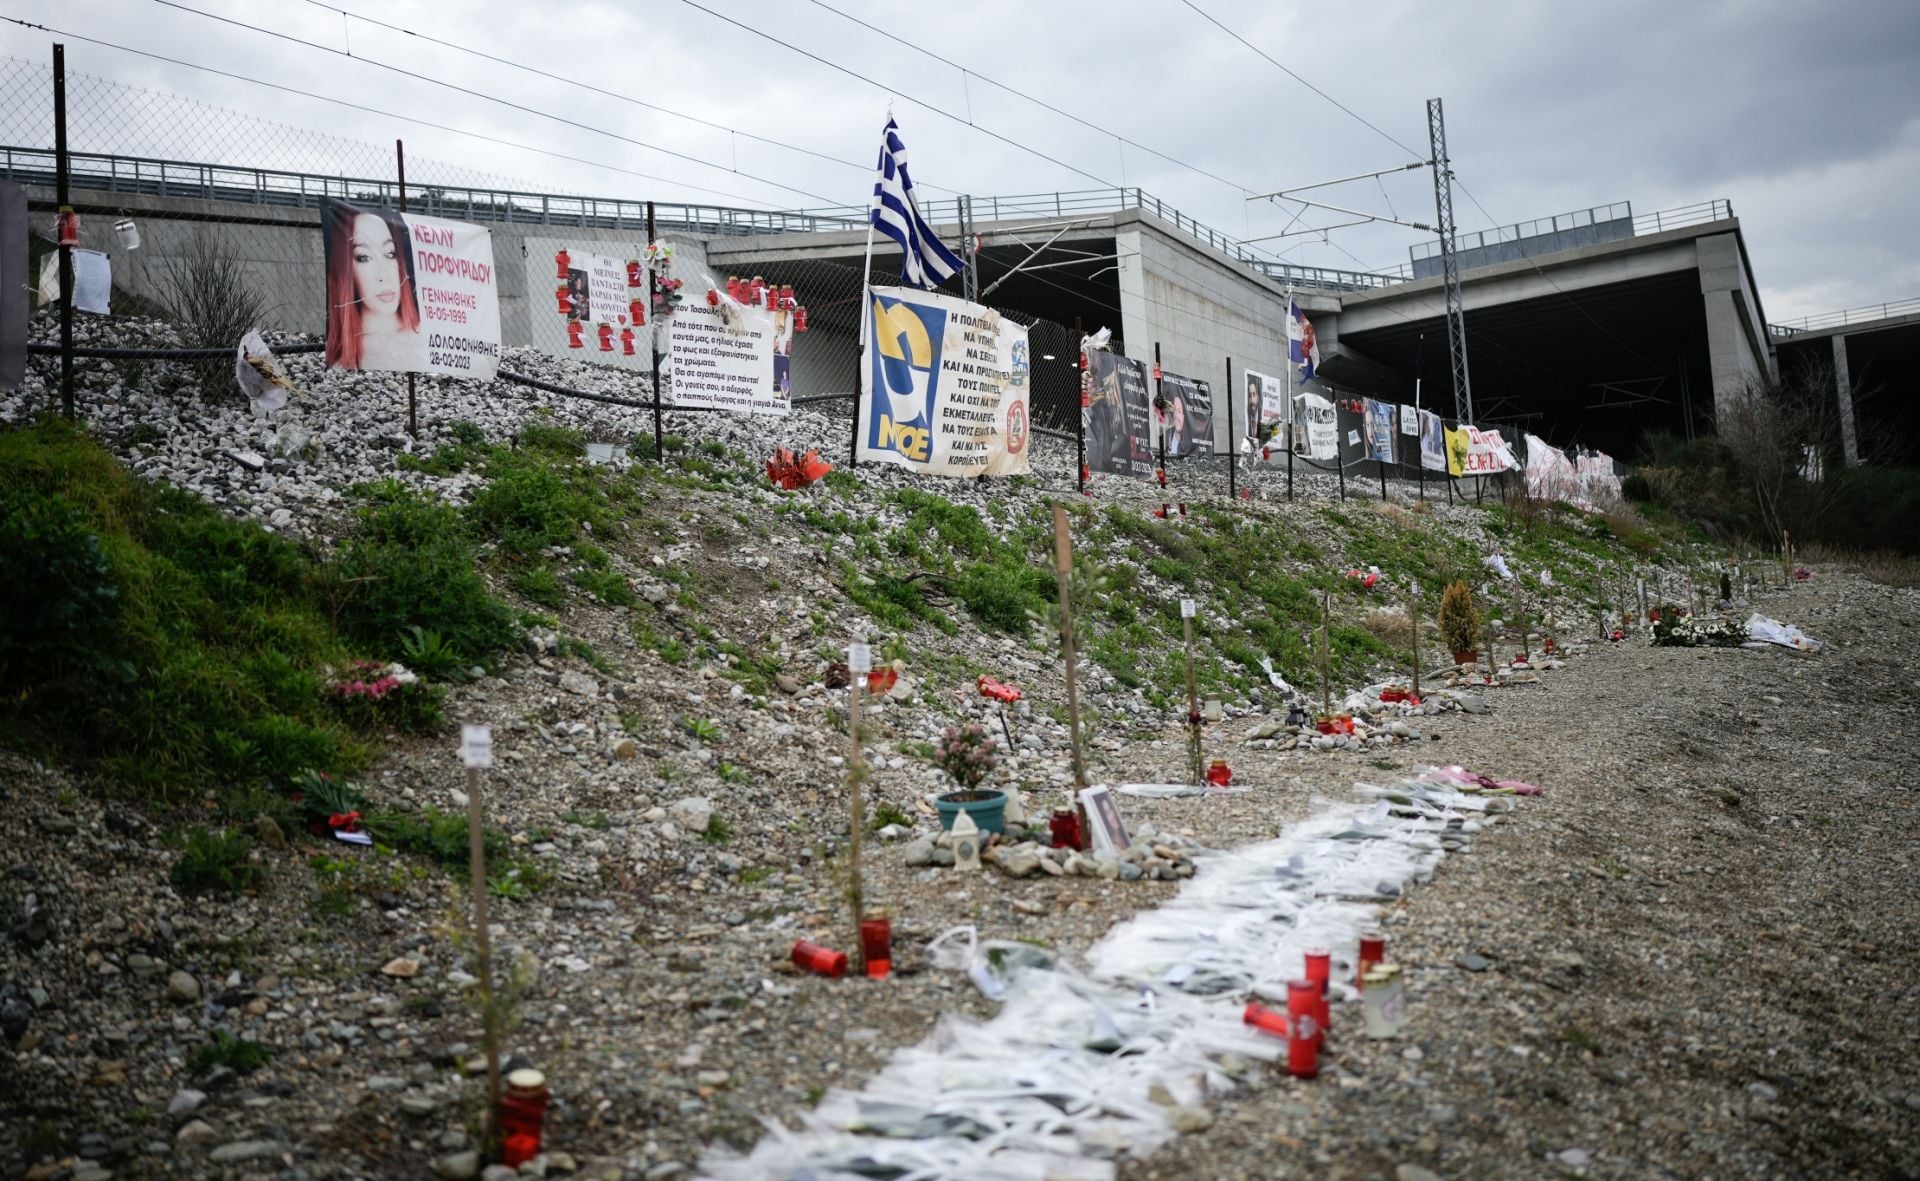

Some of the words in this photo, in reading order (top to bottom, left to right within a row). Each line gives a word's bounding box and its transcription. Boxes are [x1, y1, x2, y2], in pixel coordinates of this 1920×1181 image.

[412, 224, 454, 248] ΚΕΛΛΥ
[418, 251, 490, 284] ΠΟΡΦΥΡΙΔΟΥ
[422, 287, 477, 309] ΓΕΝΝΗΘΗΚΕ
[951, 313, 957, 323] Η
[960, 315, 991, 330] ΠΟΛΙΤΕΙΑ
[672, 320, 687, 328] Από
[750, 331, 762, 339] από
[673, 333, 694, 341] κοντά
[695, 336, 709, 345] μας,
[735, 340, 753, 349] έχασε
[964, 332, 975, 342] ΝΑ
[429, 333, 498, 357] ΔΟΛΟΦΟΝΗΘΗΚΕ
[430, 352, 471, 369] 28-02-2023
[683, 346, 697, 354] φως
[711, 348, 758, 361] εξαφανίστηκαν
[967, 348, 977, 359] ΝΑ
[943, 360, 960, 371] ΚΑΙ
[963, 363, 974, 374] ΝΑ
[675, 368, 685, 376] Θα
[697, 371, 725, 380] αγαπάμε
[727, 374, 736, 382] για
[685, 381, 705, 390] γονείς
[707, 383, 720, 391] σου,
[958, 378, 978, 390] ΤΟΥΣ
[683, 393, 712, 401] παππούς
[737, 397, 746, 405] και
[950, 393, 965, 403] ΚΑΙ
[967, 396, 979, 405] ΟΧΙ
[942, 424, 955, 434] ΝΑ
[958, 425, 974, 436] ΤΟΥΣ
[952, 440, 964, 450] ΚΑΙ
